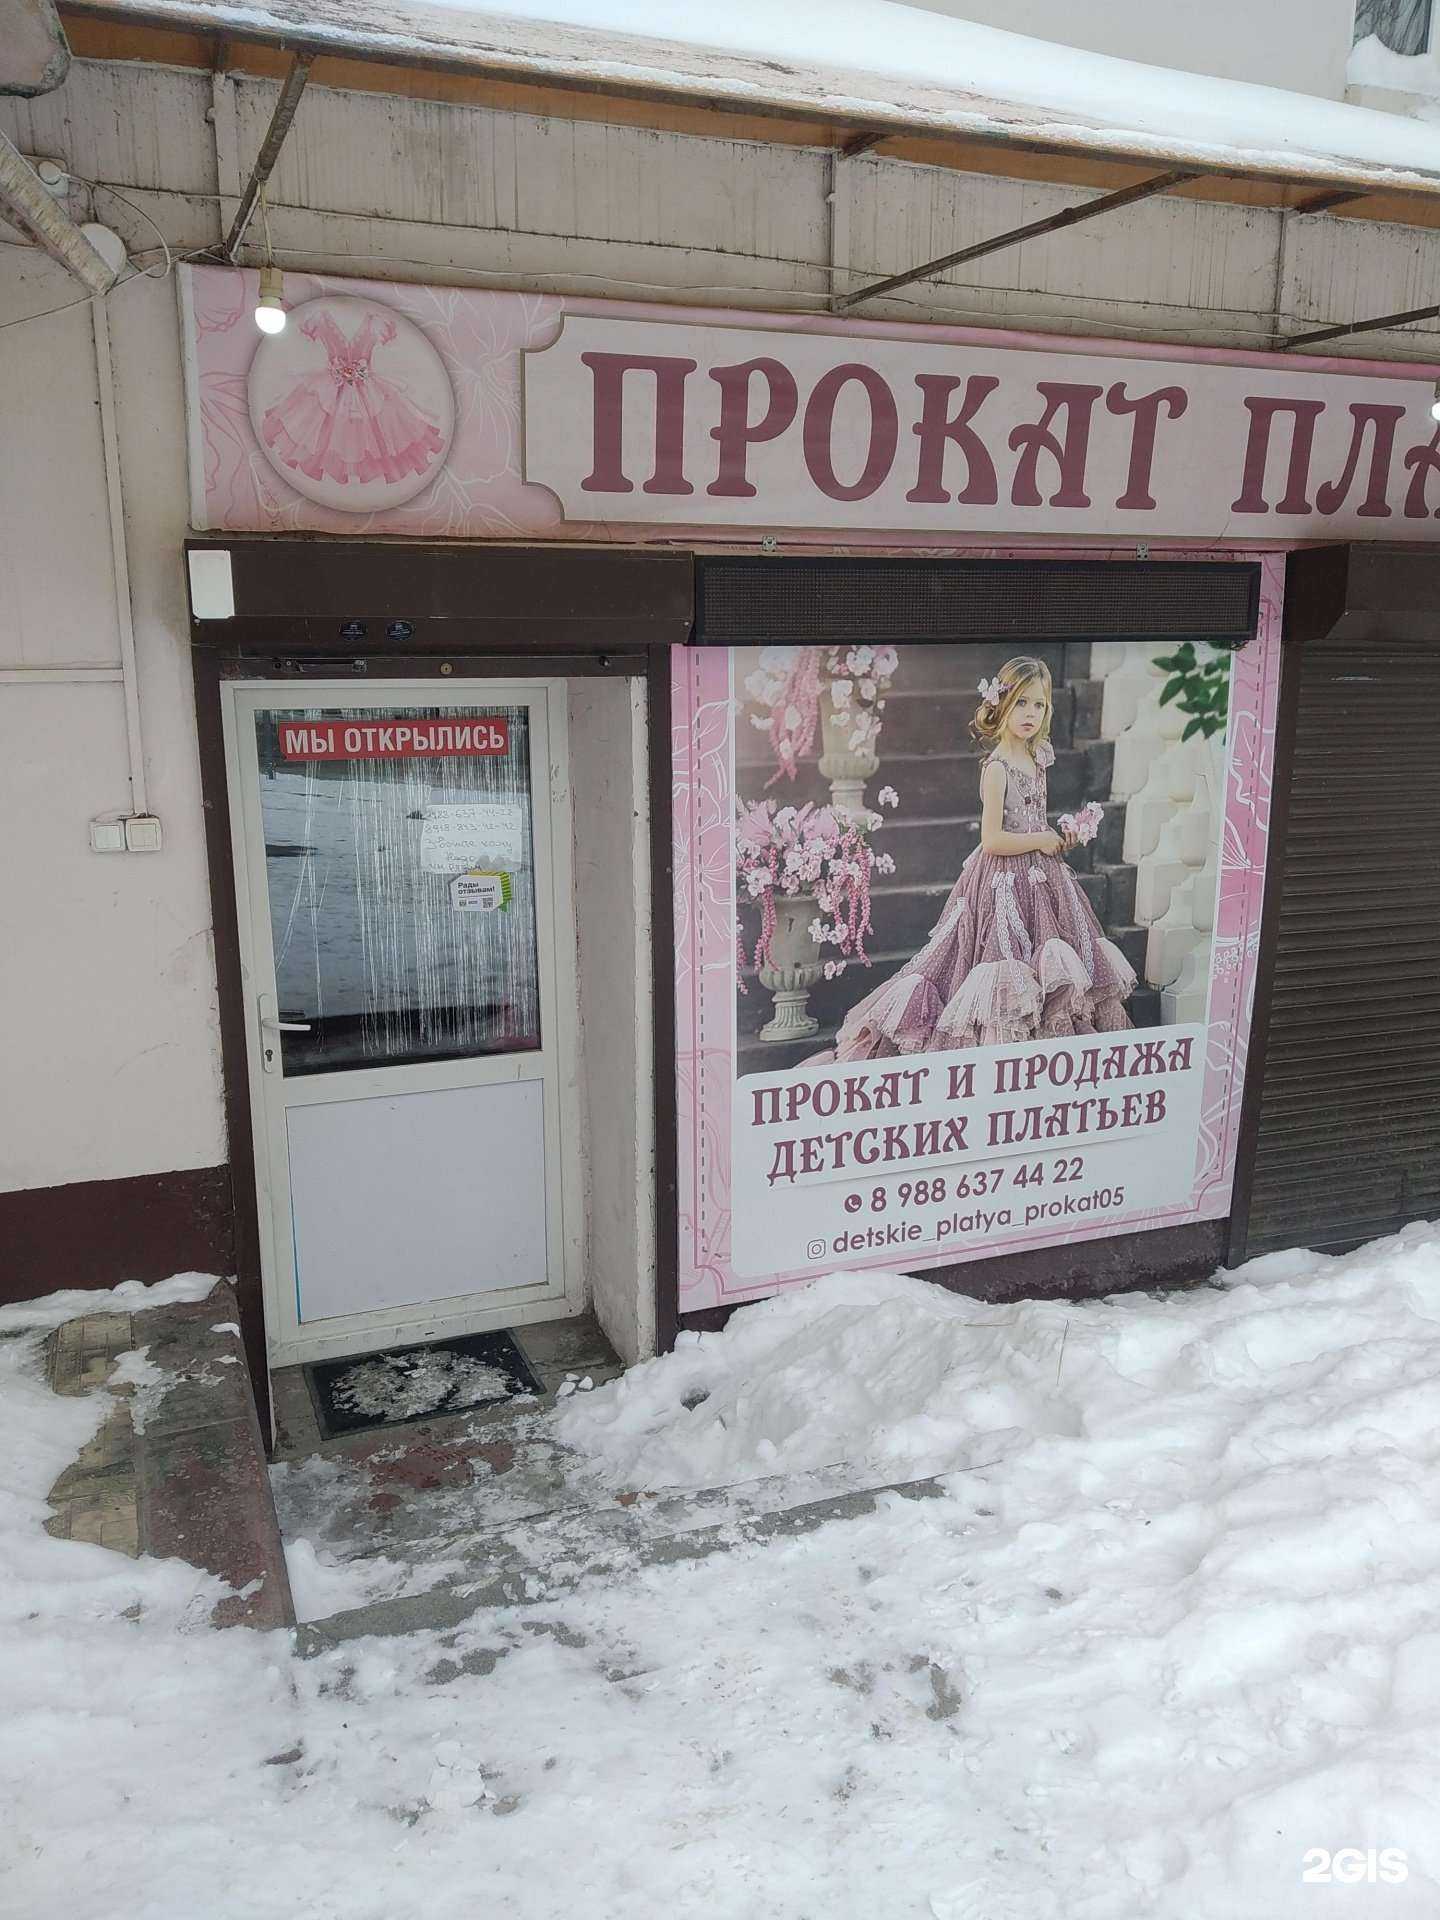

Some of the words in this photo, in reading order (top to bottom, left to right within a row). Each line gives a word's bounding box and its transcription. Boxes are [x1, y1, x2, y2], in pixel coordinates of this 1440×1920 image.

[580, 351, 1189, 510] ПРОКАТ
[285, 728, 335, 754] МЫ
[344, 725, 505, 752] ОТКРЫЛИСЬ
[458, 885, 495, 895] отзывам!
[751, 1065, 930, 1127] ПРОКАТ
[946, 1063, 977, 1101] И
[993, 1037, 1195, 1095] ПРОДАЖА
[766, 1116, 969, 1188] ДЕТСКИХ
[987, 1088, 1167, 1148] ПЛАТЬЕВ
[870, 1186, 887, 1214] 8
[898, 1177, 947, 1208] 988
[956, 1169, 1004, 1199] 637
[1013, 1164, 1044, 1190] 44
[1053, 1157, 1084, 1182] 22
[832, 1186, 1125, 1255] detskie_platya_prokat05
